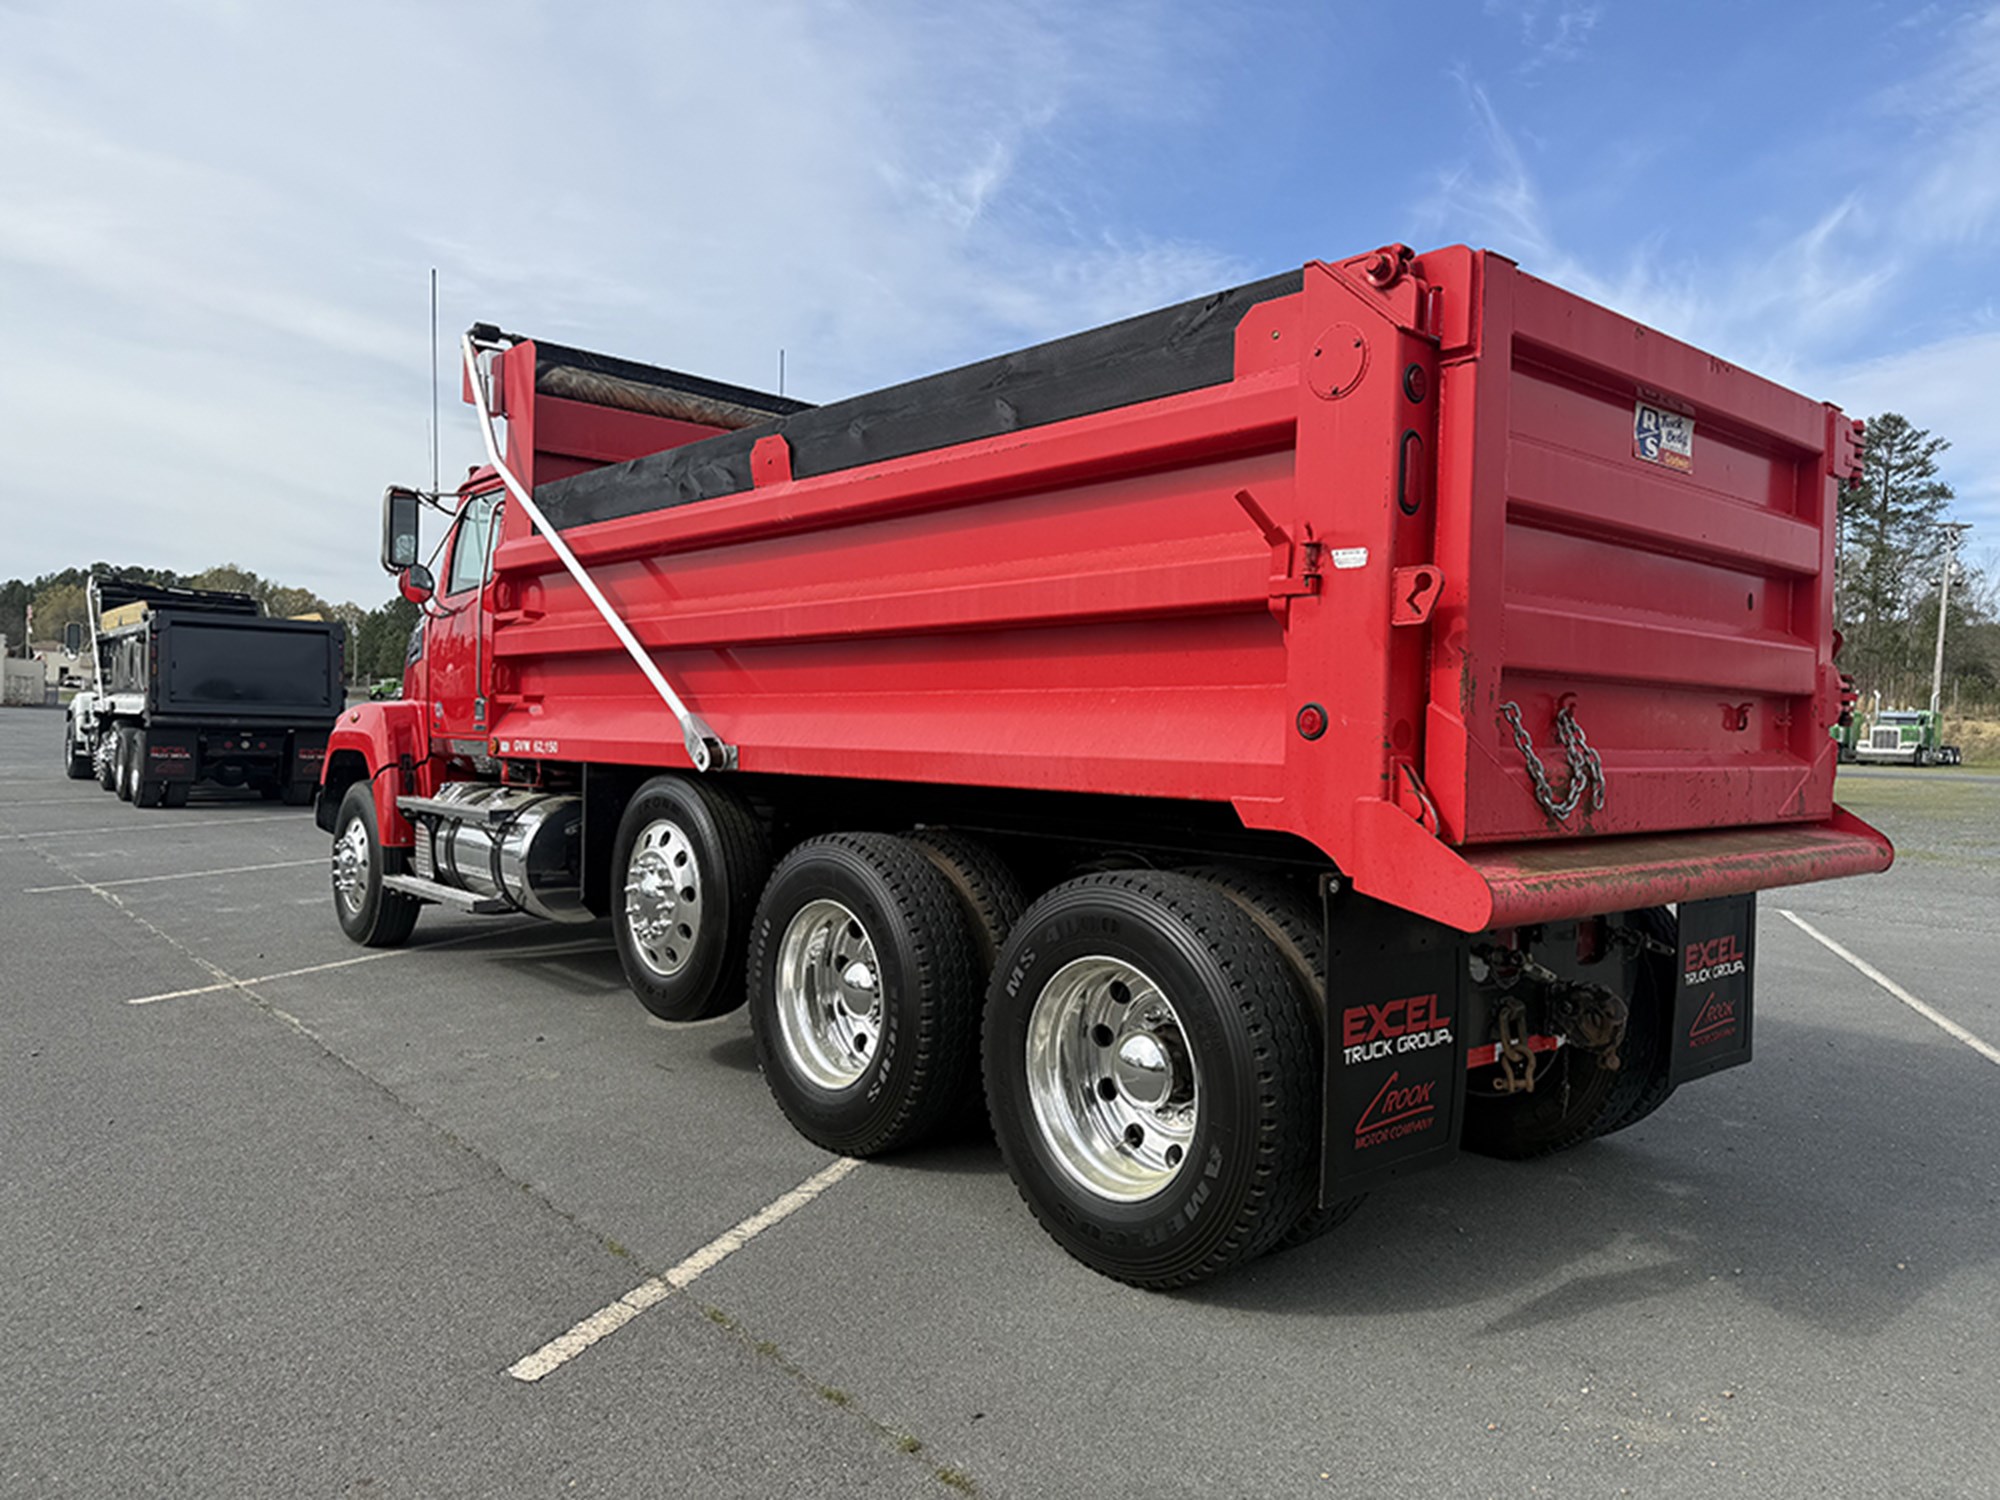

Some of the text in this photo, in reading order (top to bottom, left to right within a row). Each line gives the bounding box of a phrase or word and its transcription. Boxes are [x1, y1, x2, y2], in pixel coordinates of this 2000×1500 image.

[1684, 935, 1744, 973] EXCEL
[1005, 947, 1038, 998] MS
[1684, 972, 1711, 986] TRUCK
[1343, 994, 1451, 1047] EXCEL
[1343, 1039, 1393, 1065] TRUCK
[1355, 1117, 1435, 1150] MOTOR COMPANY
